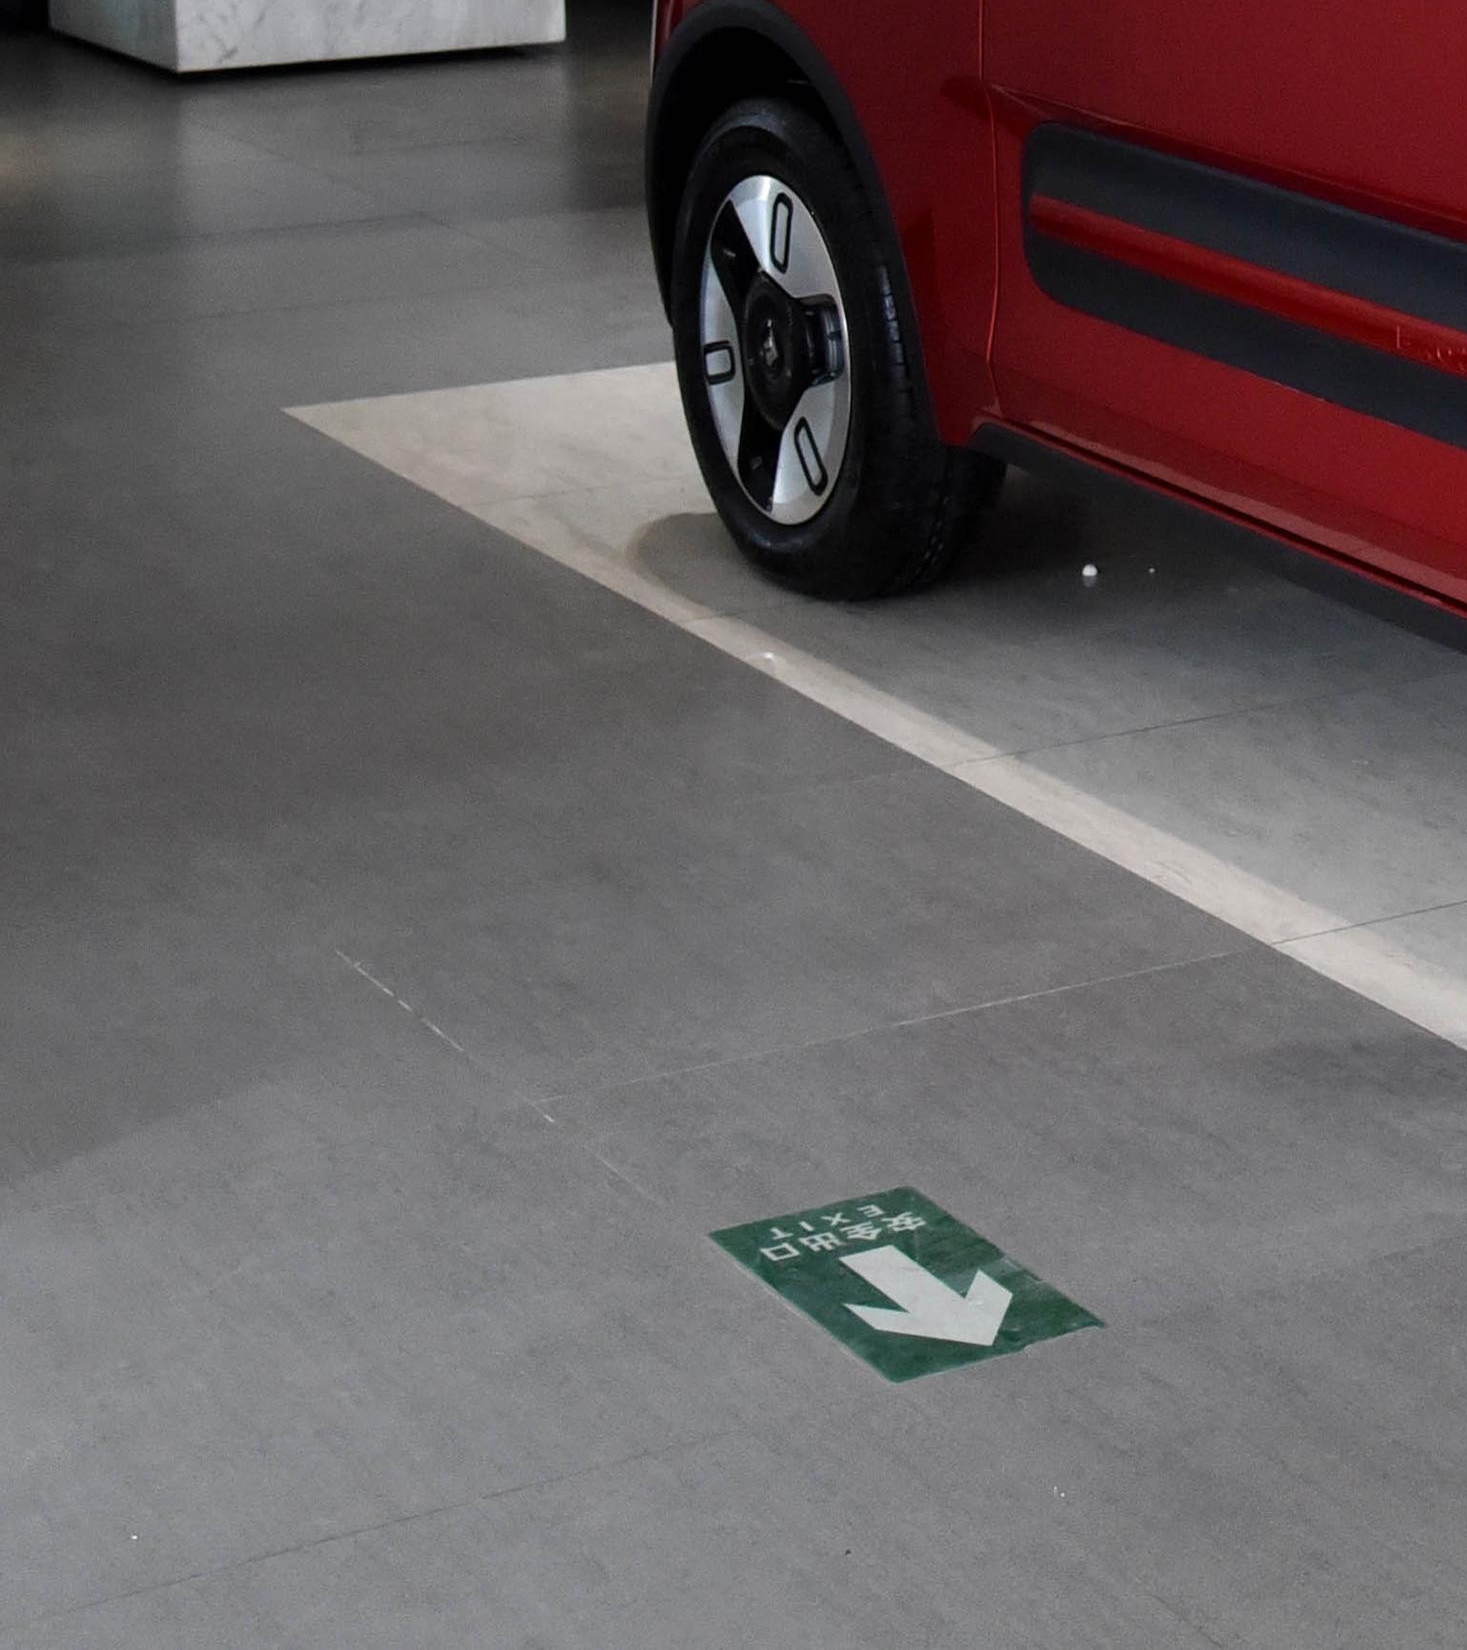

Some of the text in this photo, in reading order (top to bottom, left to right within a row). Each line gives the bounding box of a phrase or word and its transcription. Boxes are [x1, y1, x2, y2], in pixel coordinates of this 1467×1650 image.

[759, 1210, 927, 1262] 安全出口
[769, 1204, 885, 1241] EXIT
